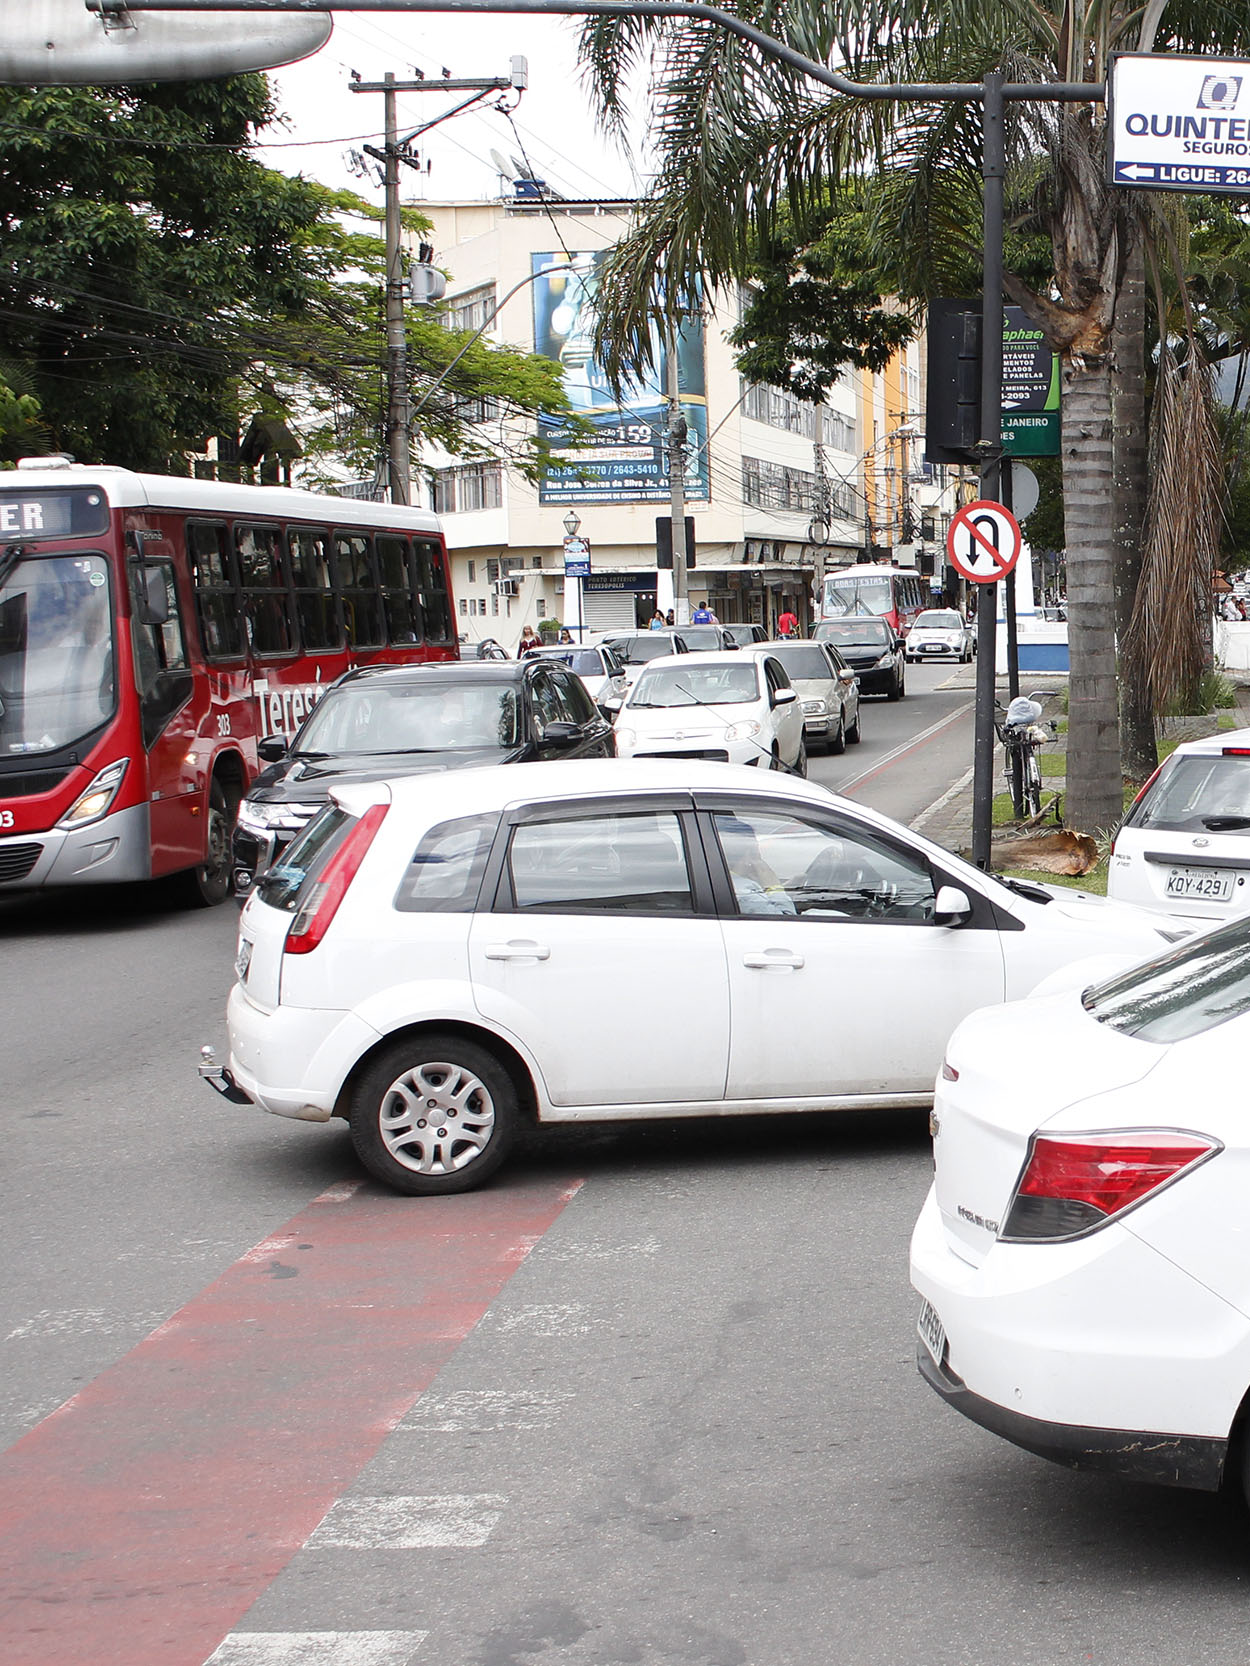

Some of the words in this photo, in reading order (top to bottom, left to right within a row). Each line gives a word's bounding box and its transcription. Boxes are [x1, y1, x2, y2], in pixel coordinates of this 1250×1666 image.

[1159, 166, 1221, 183] LIGUE:
[1001, 392, 1031, 400] -2093
[1006, 418, 1049, 427] JANEIRO
[1000, 431, 1015, 440] ES
[613, 464, 658, 475] 2643-5410
[546, 481, 562, 489] Rua
[624, 478, 644, 488] Silva
[0, 503, 44, 531] ER
[215, 713, 231, 737] 303
[0, 810, 15, 828] 3
